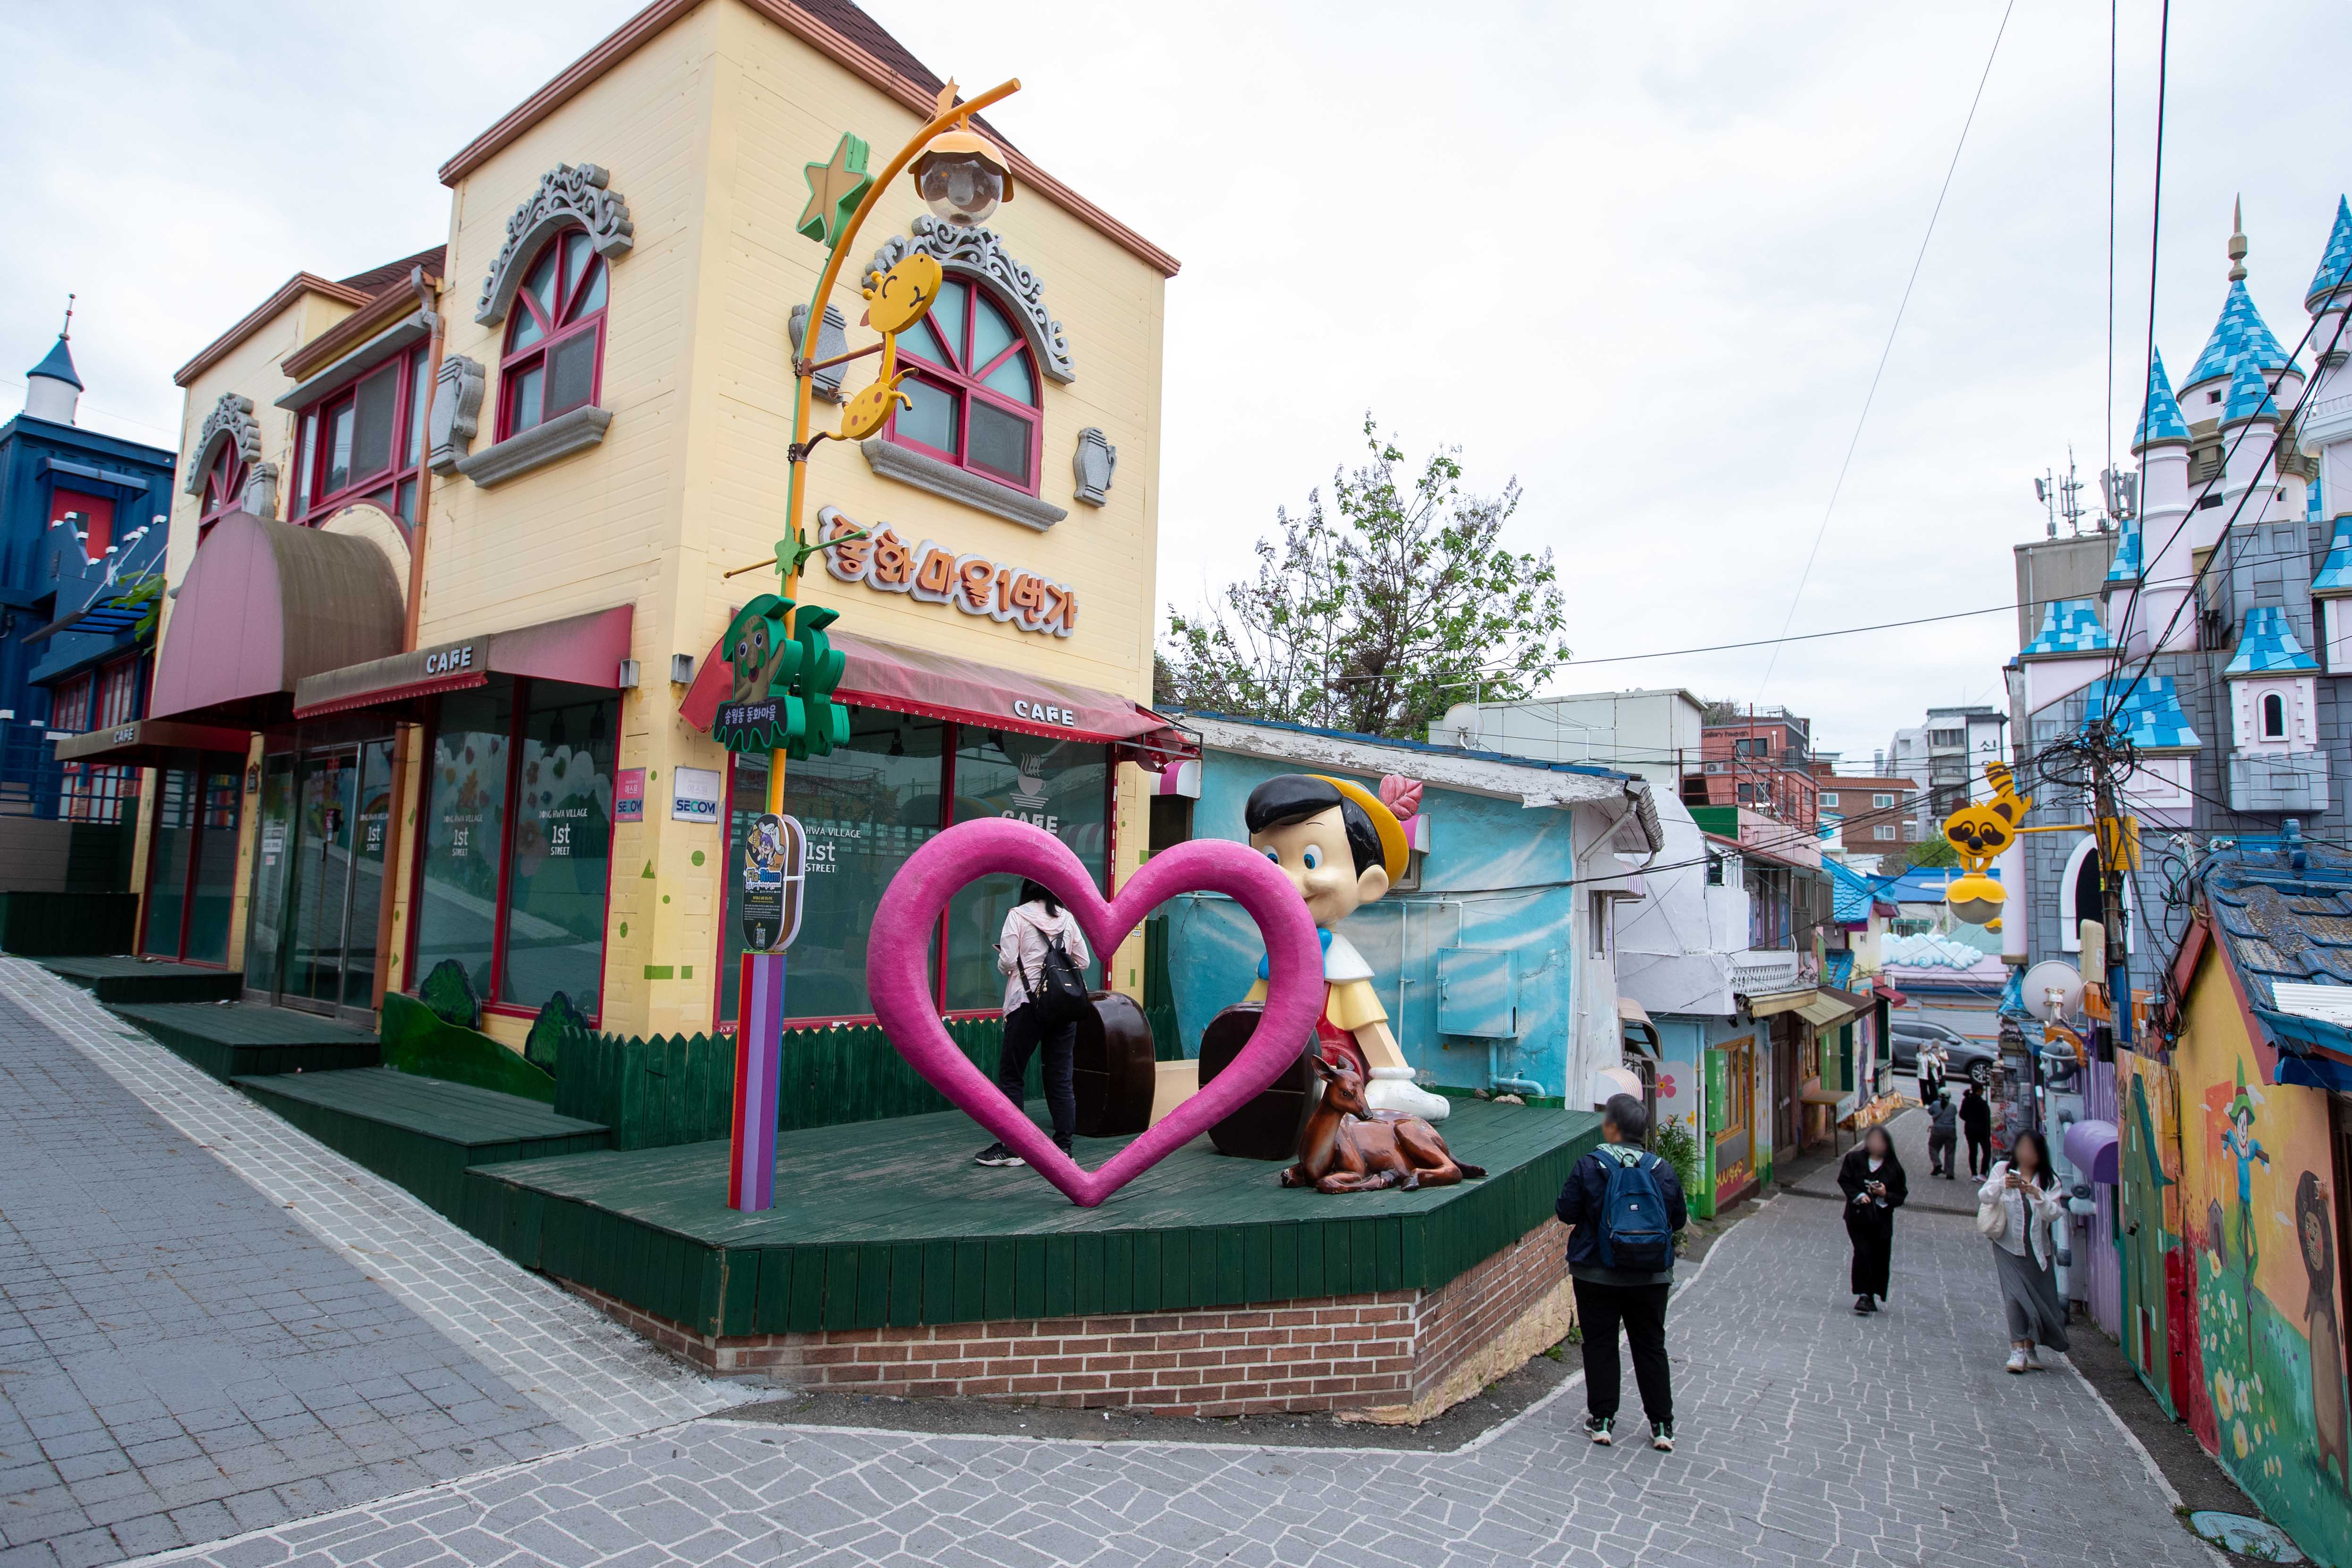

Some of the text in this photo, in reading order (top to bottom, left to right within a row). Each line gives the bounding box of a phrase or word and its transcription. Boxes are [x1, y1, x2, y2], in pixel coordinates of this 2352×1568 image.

[427, 646, 472, 674] CAFE
[725, 704, 776, 725] 송월동 동화마을
[1014, 700, 1074, 726] CAFE
[114, 728, 134, 744] CAFE
[539, 808, 588, 818] DONG HWA VILLAGE
[618, 800, 642, 813] SECOM
[676, 800, 716, 814] SECOM
[367, 824, 380, 841] 1st
[453, 827, 469, 845] 1st
[552, 823, 570, 843] 1st
[806, 826, 861, 838] HWA VILLAGE
[452, 848, 468, 856] STREET
[550, 846, 570, 855] STREET
[807, 841, 835, 861] 1st
[805, 863, 836, 873] STREET
